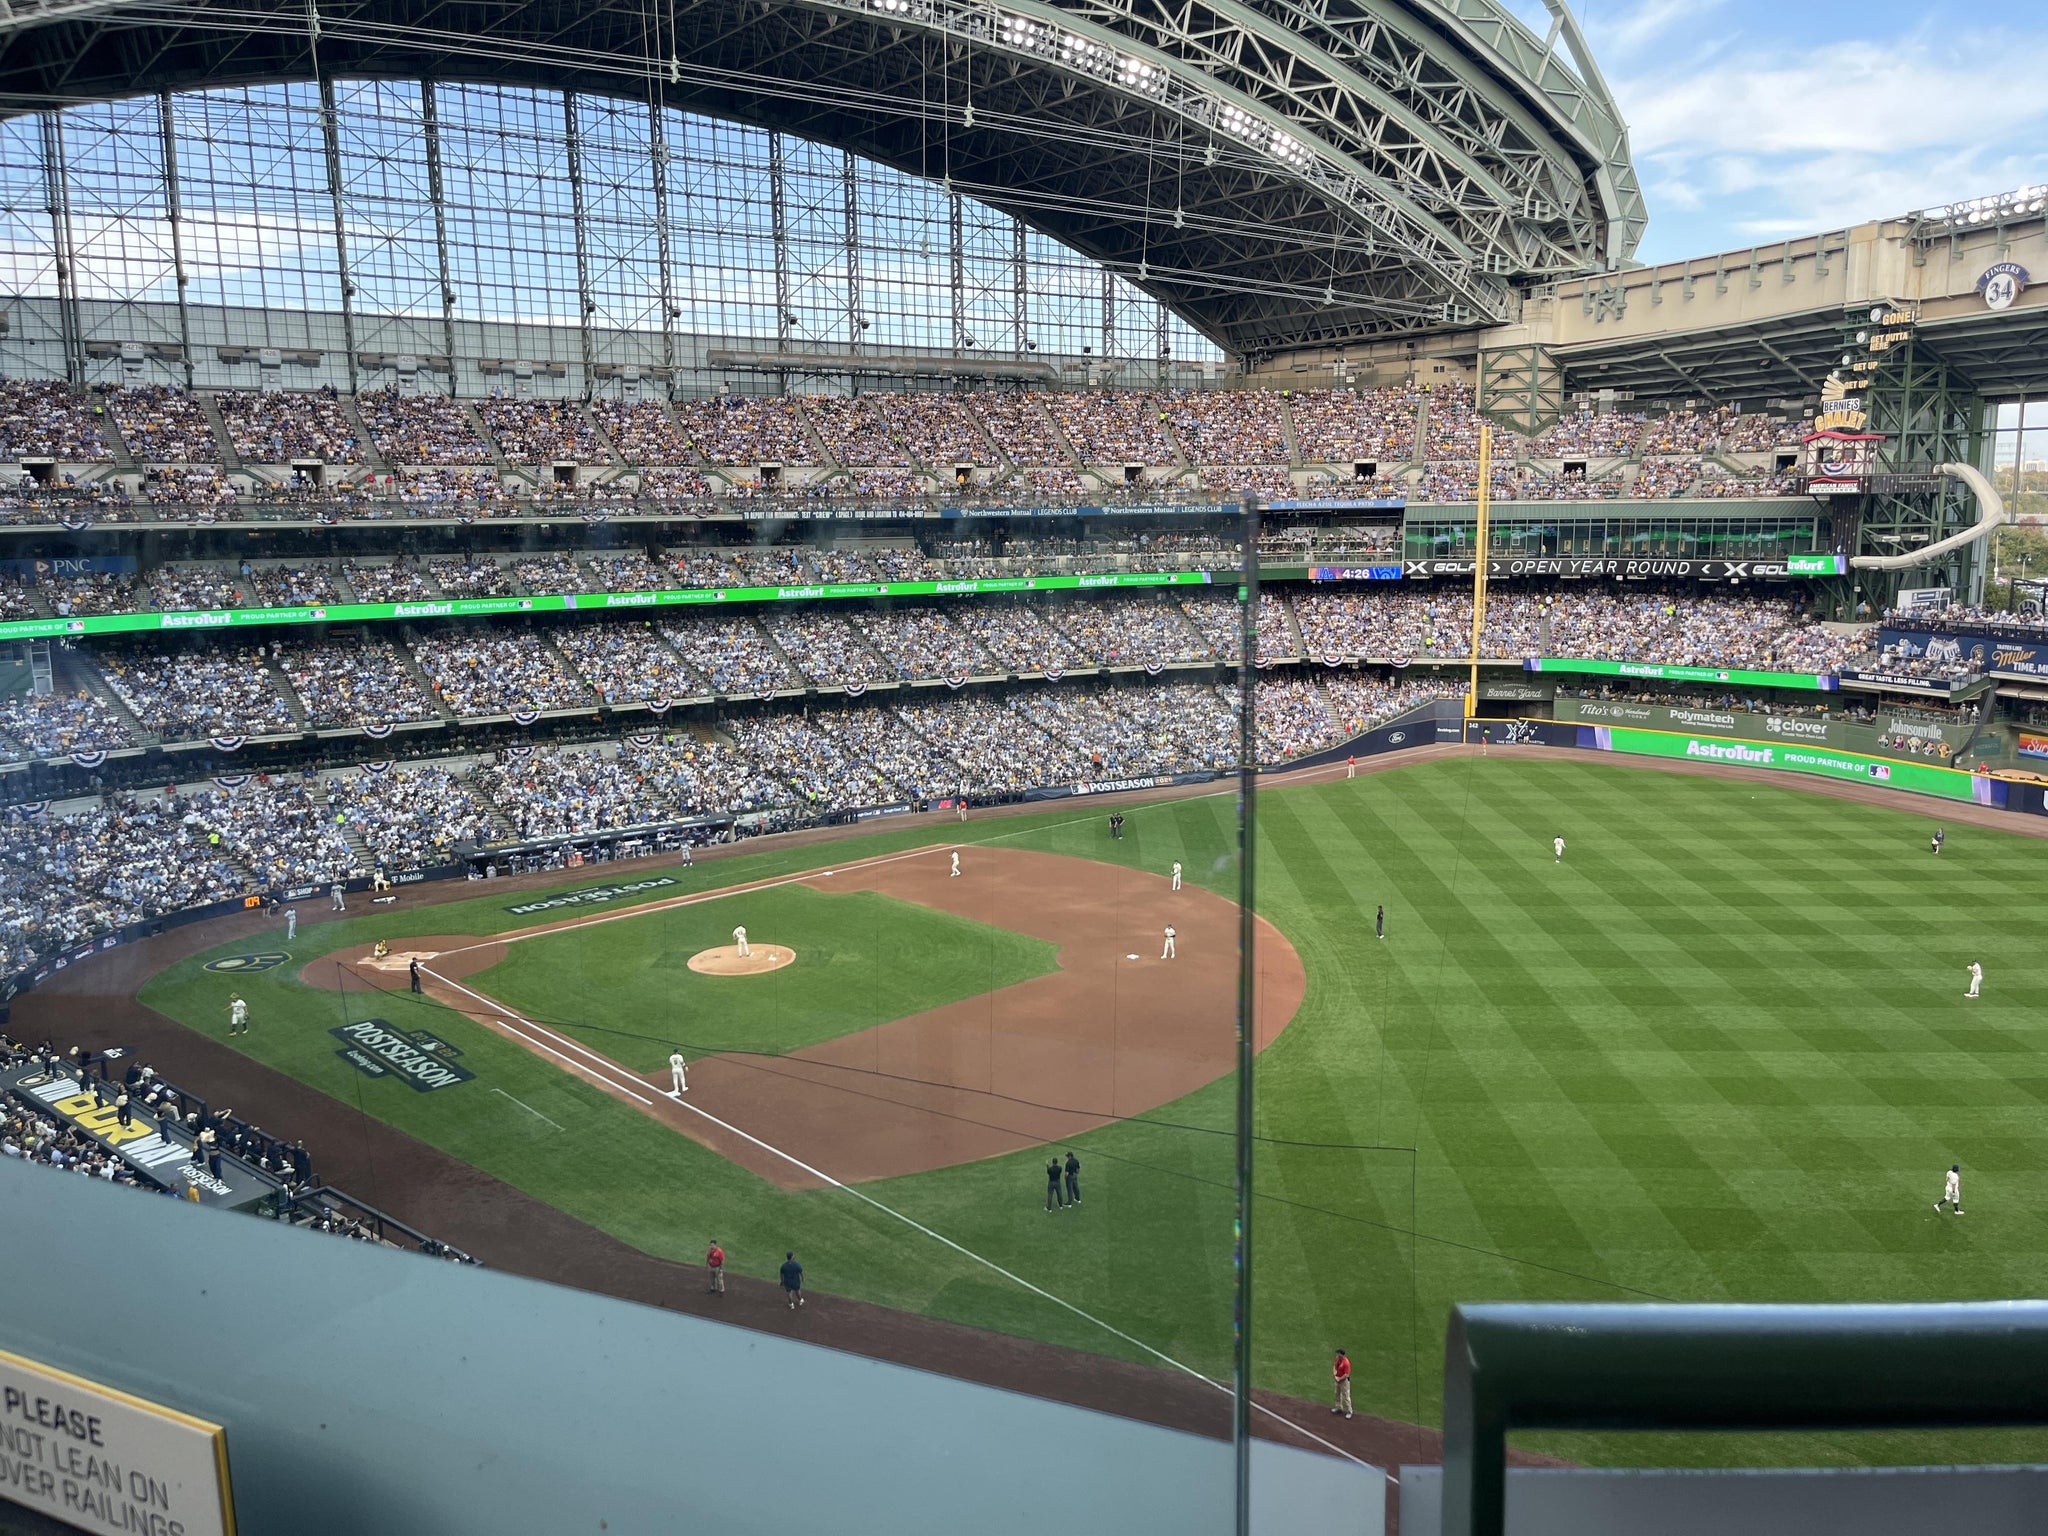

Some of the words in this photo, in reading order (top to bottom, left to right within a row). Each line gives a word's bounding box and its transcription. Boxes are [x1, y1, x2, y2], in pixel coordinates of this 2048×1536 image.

[1985, 264, 2020, 279] FINGERS
[1989, 280, 2013, 303] 34
[1883, 311, 1915, 325] GONE!
[1870, 335, 1884, 343] GET
[1885, 331, 1908, 342] OUTTA
[1870, 342, 1889, 351] HERE
[1853, 362, 1867, 371] GET
[1868, 361, 1878, 370] UP
[1844, 381, 1857, 389] GET
[1858, 380, 1869, 389] UP
[1824, 399, 1859, 412] BERNIE'S
[1815, 411, 1867, 432] CHALET
[969, 509, 1010, 517] Northwestern
[1011, 508, 1032, 516] Mutual
[53, 558, 92, 574] PNC
[1405, 561, 1428, 574] X
[1433, 562, 1476, 572] GOLF
[1510, 560, 1562, 573] OPEN
[1570, 560, 1618, 573] YEAR
[1626, 561, 1691, 575] ROUND
[1723, 562, 1748, 576] X
[1752, 564, 1792, 575] GOL
[1342, 569, 1370, 579] 4:26
[606, 593, 657, 606] AstroTurf
[266, 611, 297, 619] PARTNER
[394, 603, 453, 616] AstroTurf
[161, 612, 233, 627] AstroTurf
[0, 626, 18, 634] ROUD
[19, 624, 53, 632] PARTNER
[1991, 650, 2037, 668] Miller
[1619, 664, 1664, 676] AstroTurf
[2013, 662, 2037, 674] TIME,
[1858, 673, 1876, 681] GREAT
[1893, 676, 1908, 684] LESS
[1487, 688, 1517, 698] Barrel
[1518, 688, 1542, 700] Yard
[1580, 704, 1609, 717] Tito's
[1670, 709, 1735, 725] Polymatech
[1782, 719, 1827, 734] clover
[1888, 718, 1942, 740] Johnsonville
[1686, 740, 1775, 763] AstroTurf
[1784, 753, 1815, 764] PROUD
[1817, 757, 1852, 771] PARTNER
[1854, 764, 1865, 772] OF
[1089, 777, 1154, 793] POSTSEASON
[399, 873, 425, 882] Mobile
[297, 887, 313, 896] SHOP
[511, 877, 676, 914] POSTSEASON
[343, 1021, 462, 1088] POSTSEASON
[53, 1093, 154, 1145] OUR
[177, 1164, 233, 1196] POSTSEASON
[4, 1386, 104, 1447] PLEASE
[0, 1421, 45, 1463] NOT
[53, 1441, 122, 1493] LEAN
[130, 1471, 170, 1511] ON
[62, 1479, 185, 1536] RAILINGS
